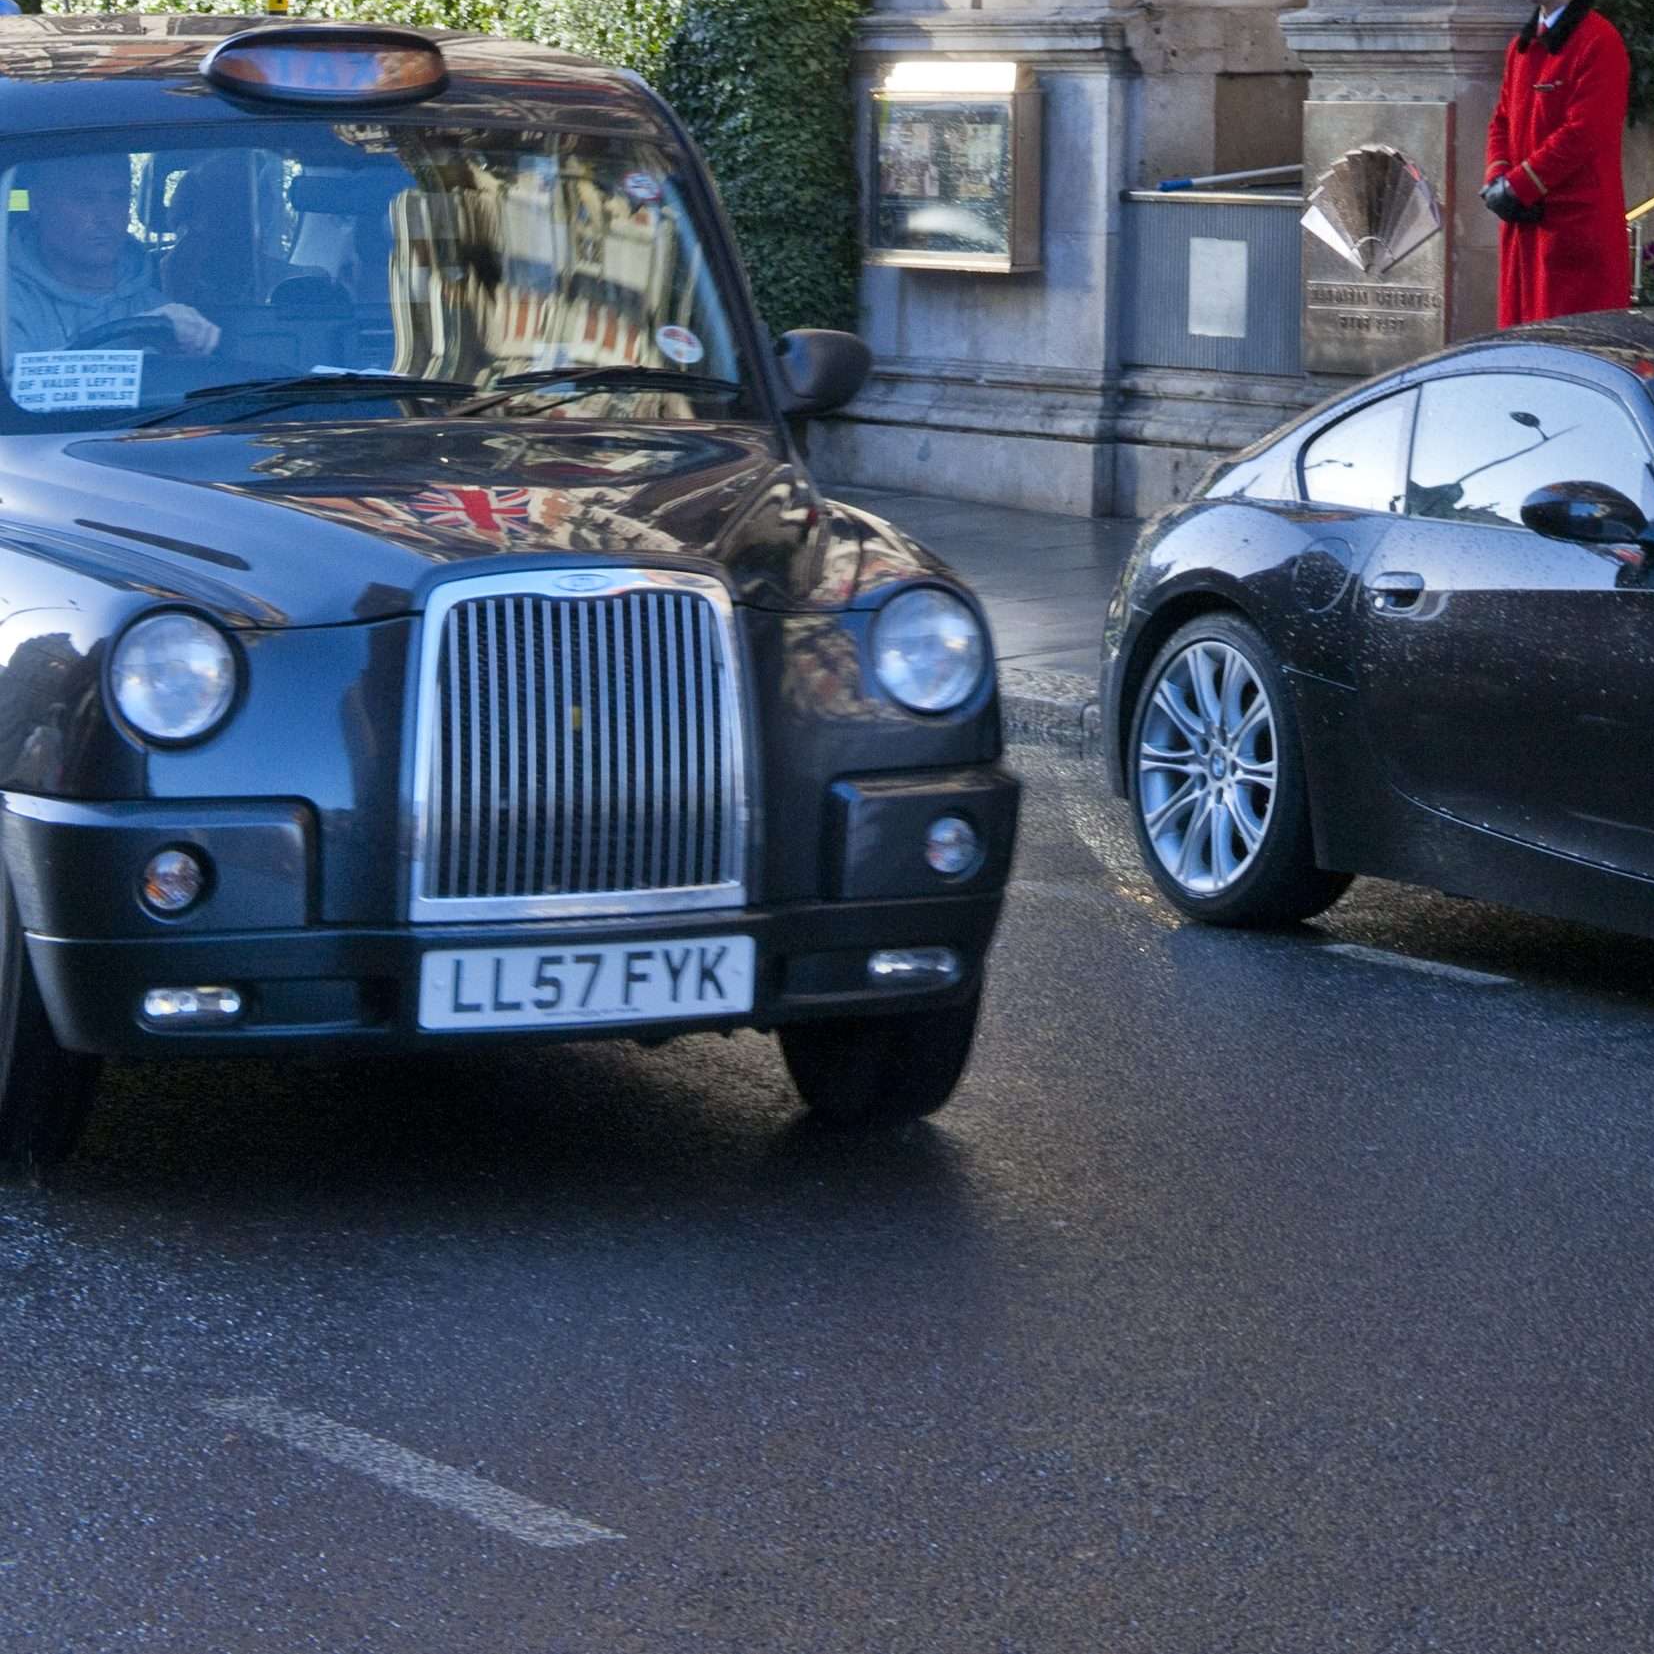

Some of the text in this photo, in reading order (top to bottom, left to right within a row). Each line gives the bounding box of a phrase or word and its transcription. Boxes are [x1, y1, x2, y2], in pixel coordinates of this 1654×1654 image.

[86, 377, 117, 387] LEFT
[53, 391, 78, 402] CAB
[452, 945, 729, 1014] LL57 FYK
